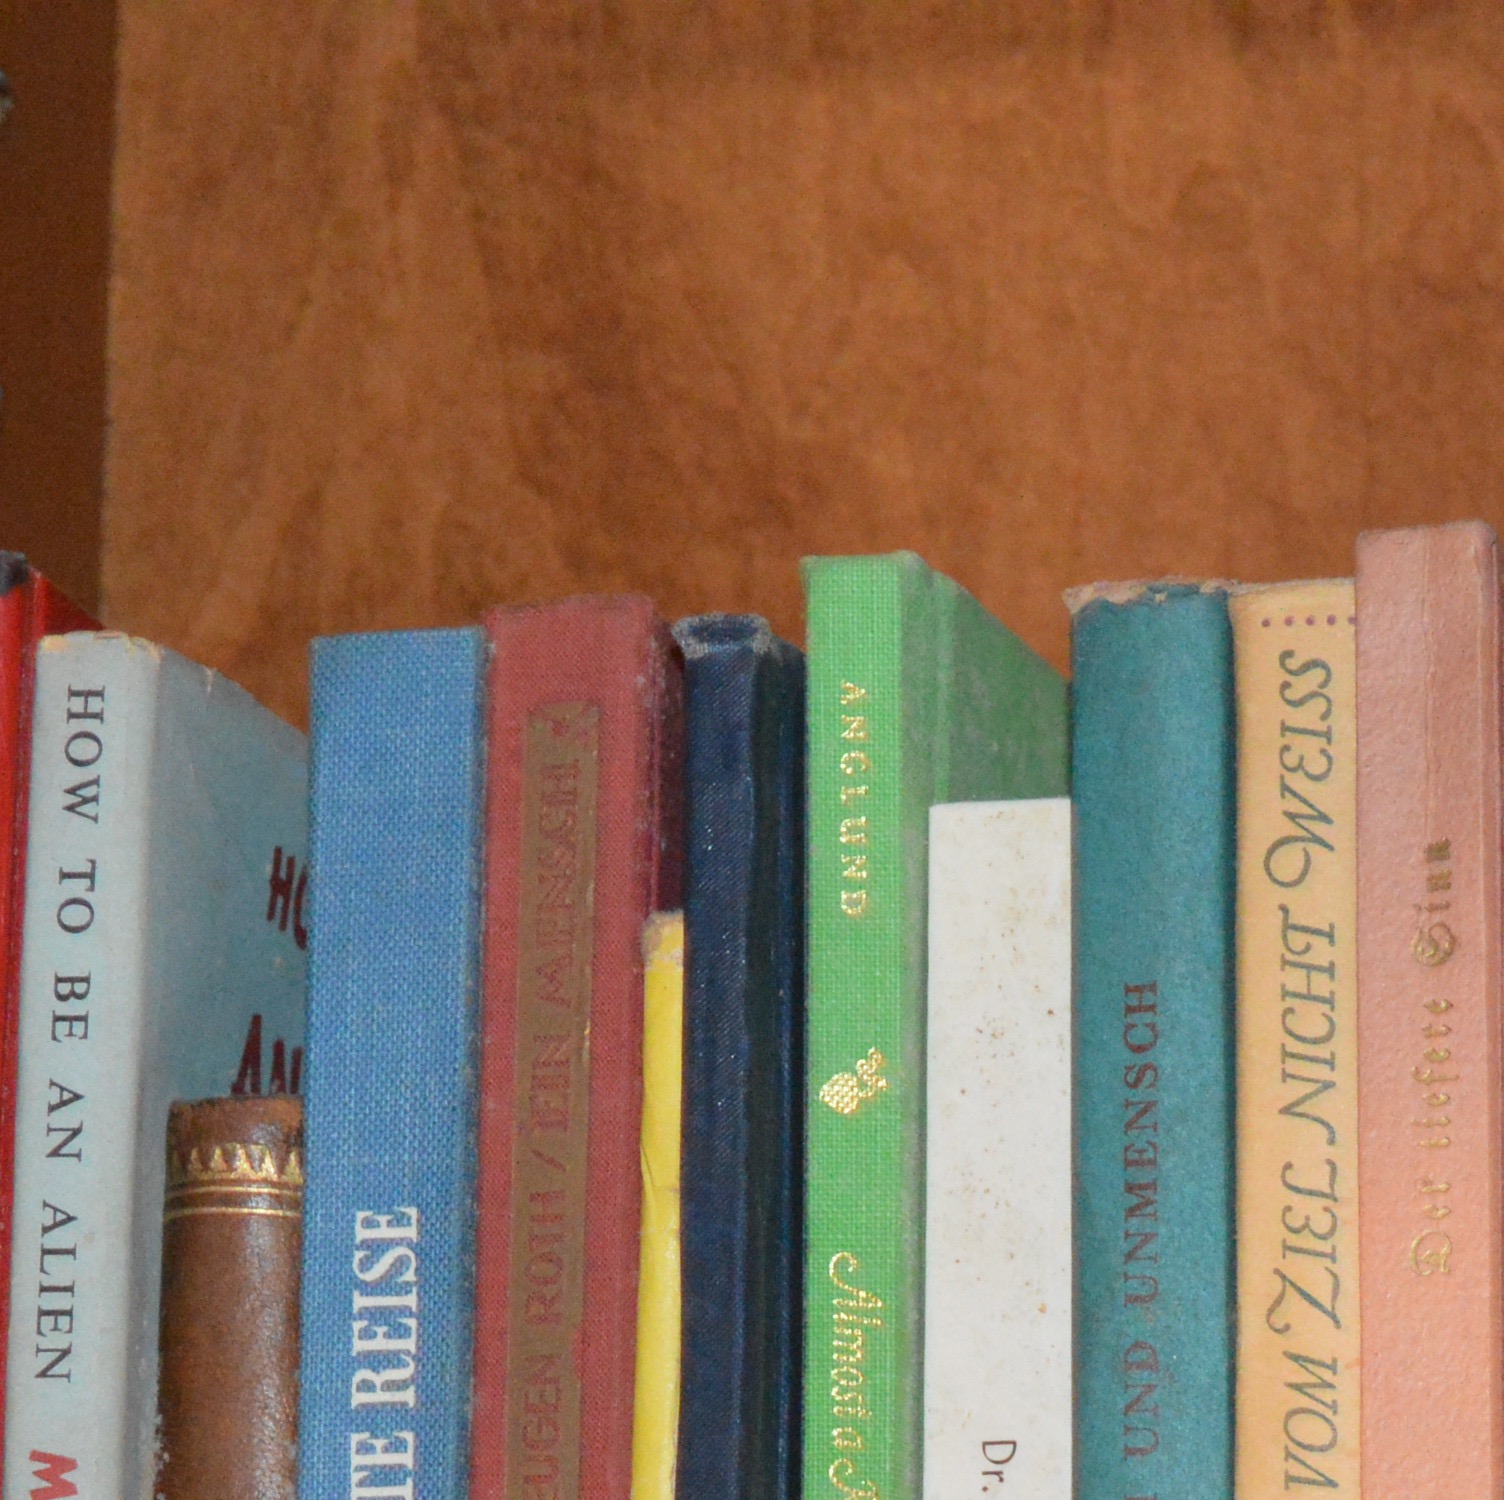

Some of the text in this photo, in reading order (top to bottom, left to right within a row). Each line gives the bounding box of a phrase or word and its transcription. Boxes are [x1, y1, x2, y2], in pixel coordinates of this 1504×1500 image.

[839, 680, 870, 917] ANGLUND
[1263, 648, 1336, 888] WEISS
[533, 758, 583, 1003] MENSCH
[1411, 837, 1457, 966] Sinn
[34, 684, 106, 1384] HOW TO BE AN ALIEN
[528, 1033, 572, 1132] EIN
[1278, 903, 1338, 1147] NICHT
[1123, 979, 1160, 1304] UNMENSCH
[1409, 1177, 1454, 1277] Der
[350, 1206, 419, 1406] REISE
[523, 1189, 566, 1327] ROTH
[1266, 1157, 1341, 1335] ZIEL
[828, 1251, 884, 1419] Almost
[1122, 1340, 1160, 1458] UND
[1284, 1352, 1339, 1491] VOM
[980, 1439, 1018, 1492] Dr.
